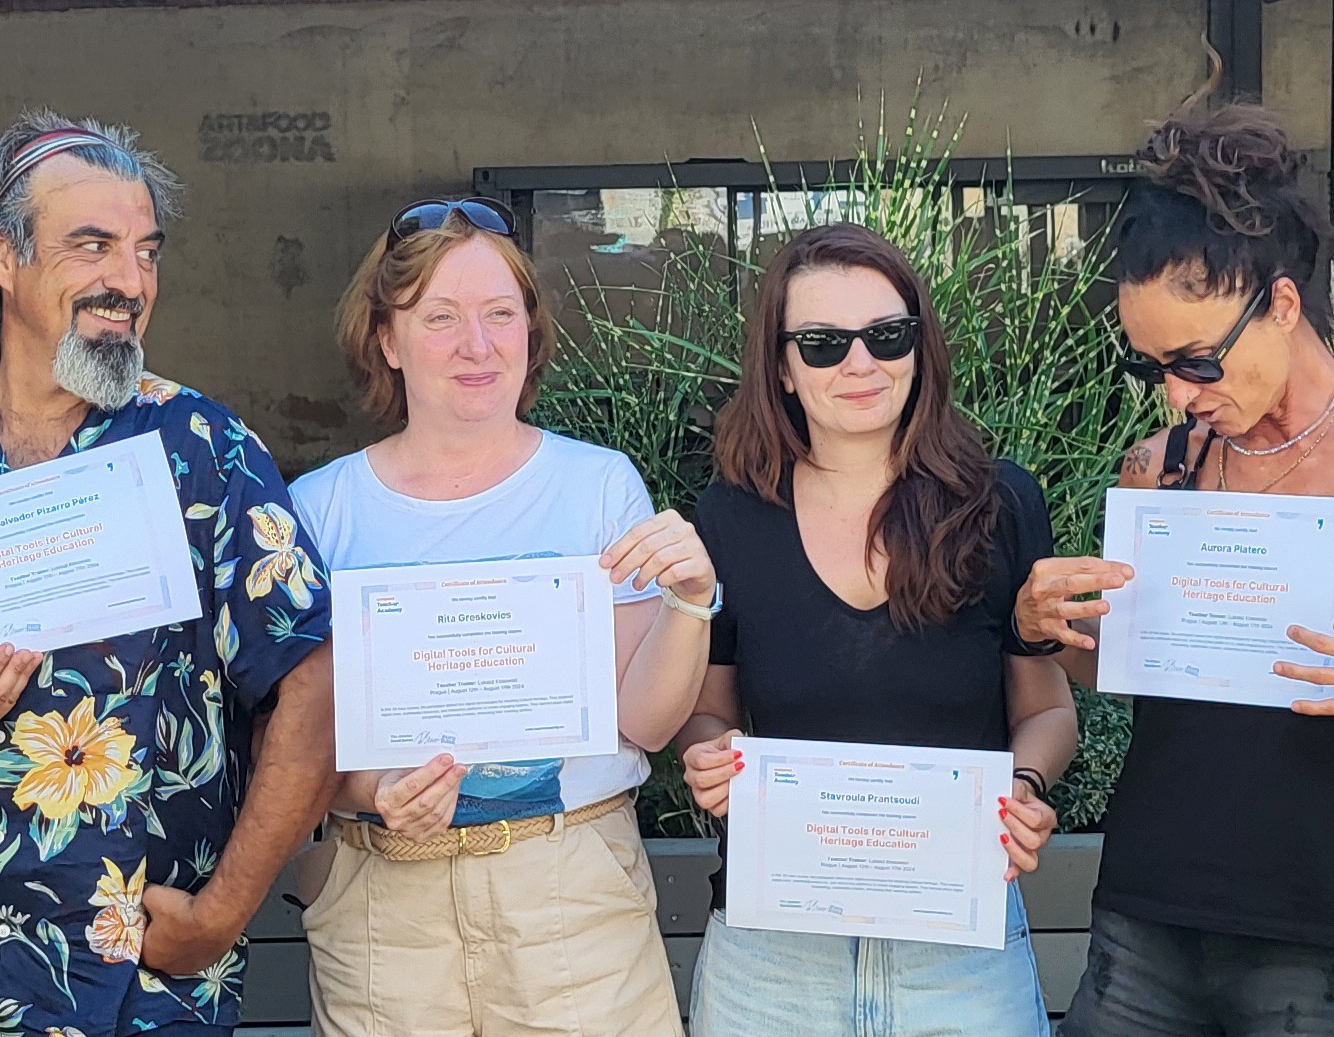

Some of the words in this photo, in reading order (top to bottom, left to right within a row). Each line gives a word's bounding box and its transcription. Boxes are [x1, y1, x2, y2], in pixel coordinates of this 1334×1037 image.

[37, 502, 70, 515] Pizarro
[15, 540, 43, 552] Tools
[46, 536, 60, 544] for
[63, 523, 102, 539] Cultural
[43, 538, 94, 556] Education
[1201, 543, 1231, 552] Aurora
[1234, 545, 1266, 554] Platero
[1172, 577, 1201, 588] Digital
[1204, 578, 1230, 588] Tools
[1233, 580, 1246, 589] for
[1249, 581, 1288, 592] Cultural
[1183, 590, 1224, 602] Heritage
[1227, 592, 1275, 604] Education
[438, 615, 455, 623] Rita
[414, 649, 445, 661] Digital
[448, 648, 476, 657] Tools
[479, 647, 493, 655] for
[496, 643, 535, 654] Cultural
[428, 661, 471, 671] Heritage
[474, 657, 524, 667] Education
[807, 824, 838, 834] Digital
[841, 826, 868, 835] Tools
[872, 827, 886, 836] for
[889, 829, 929, 838] Cultural
[820, 836, 863, 847] Heritage
[866, 839, 916, 849] Education
